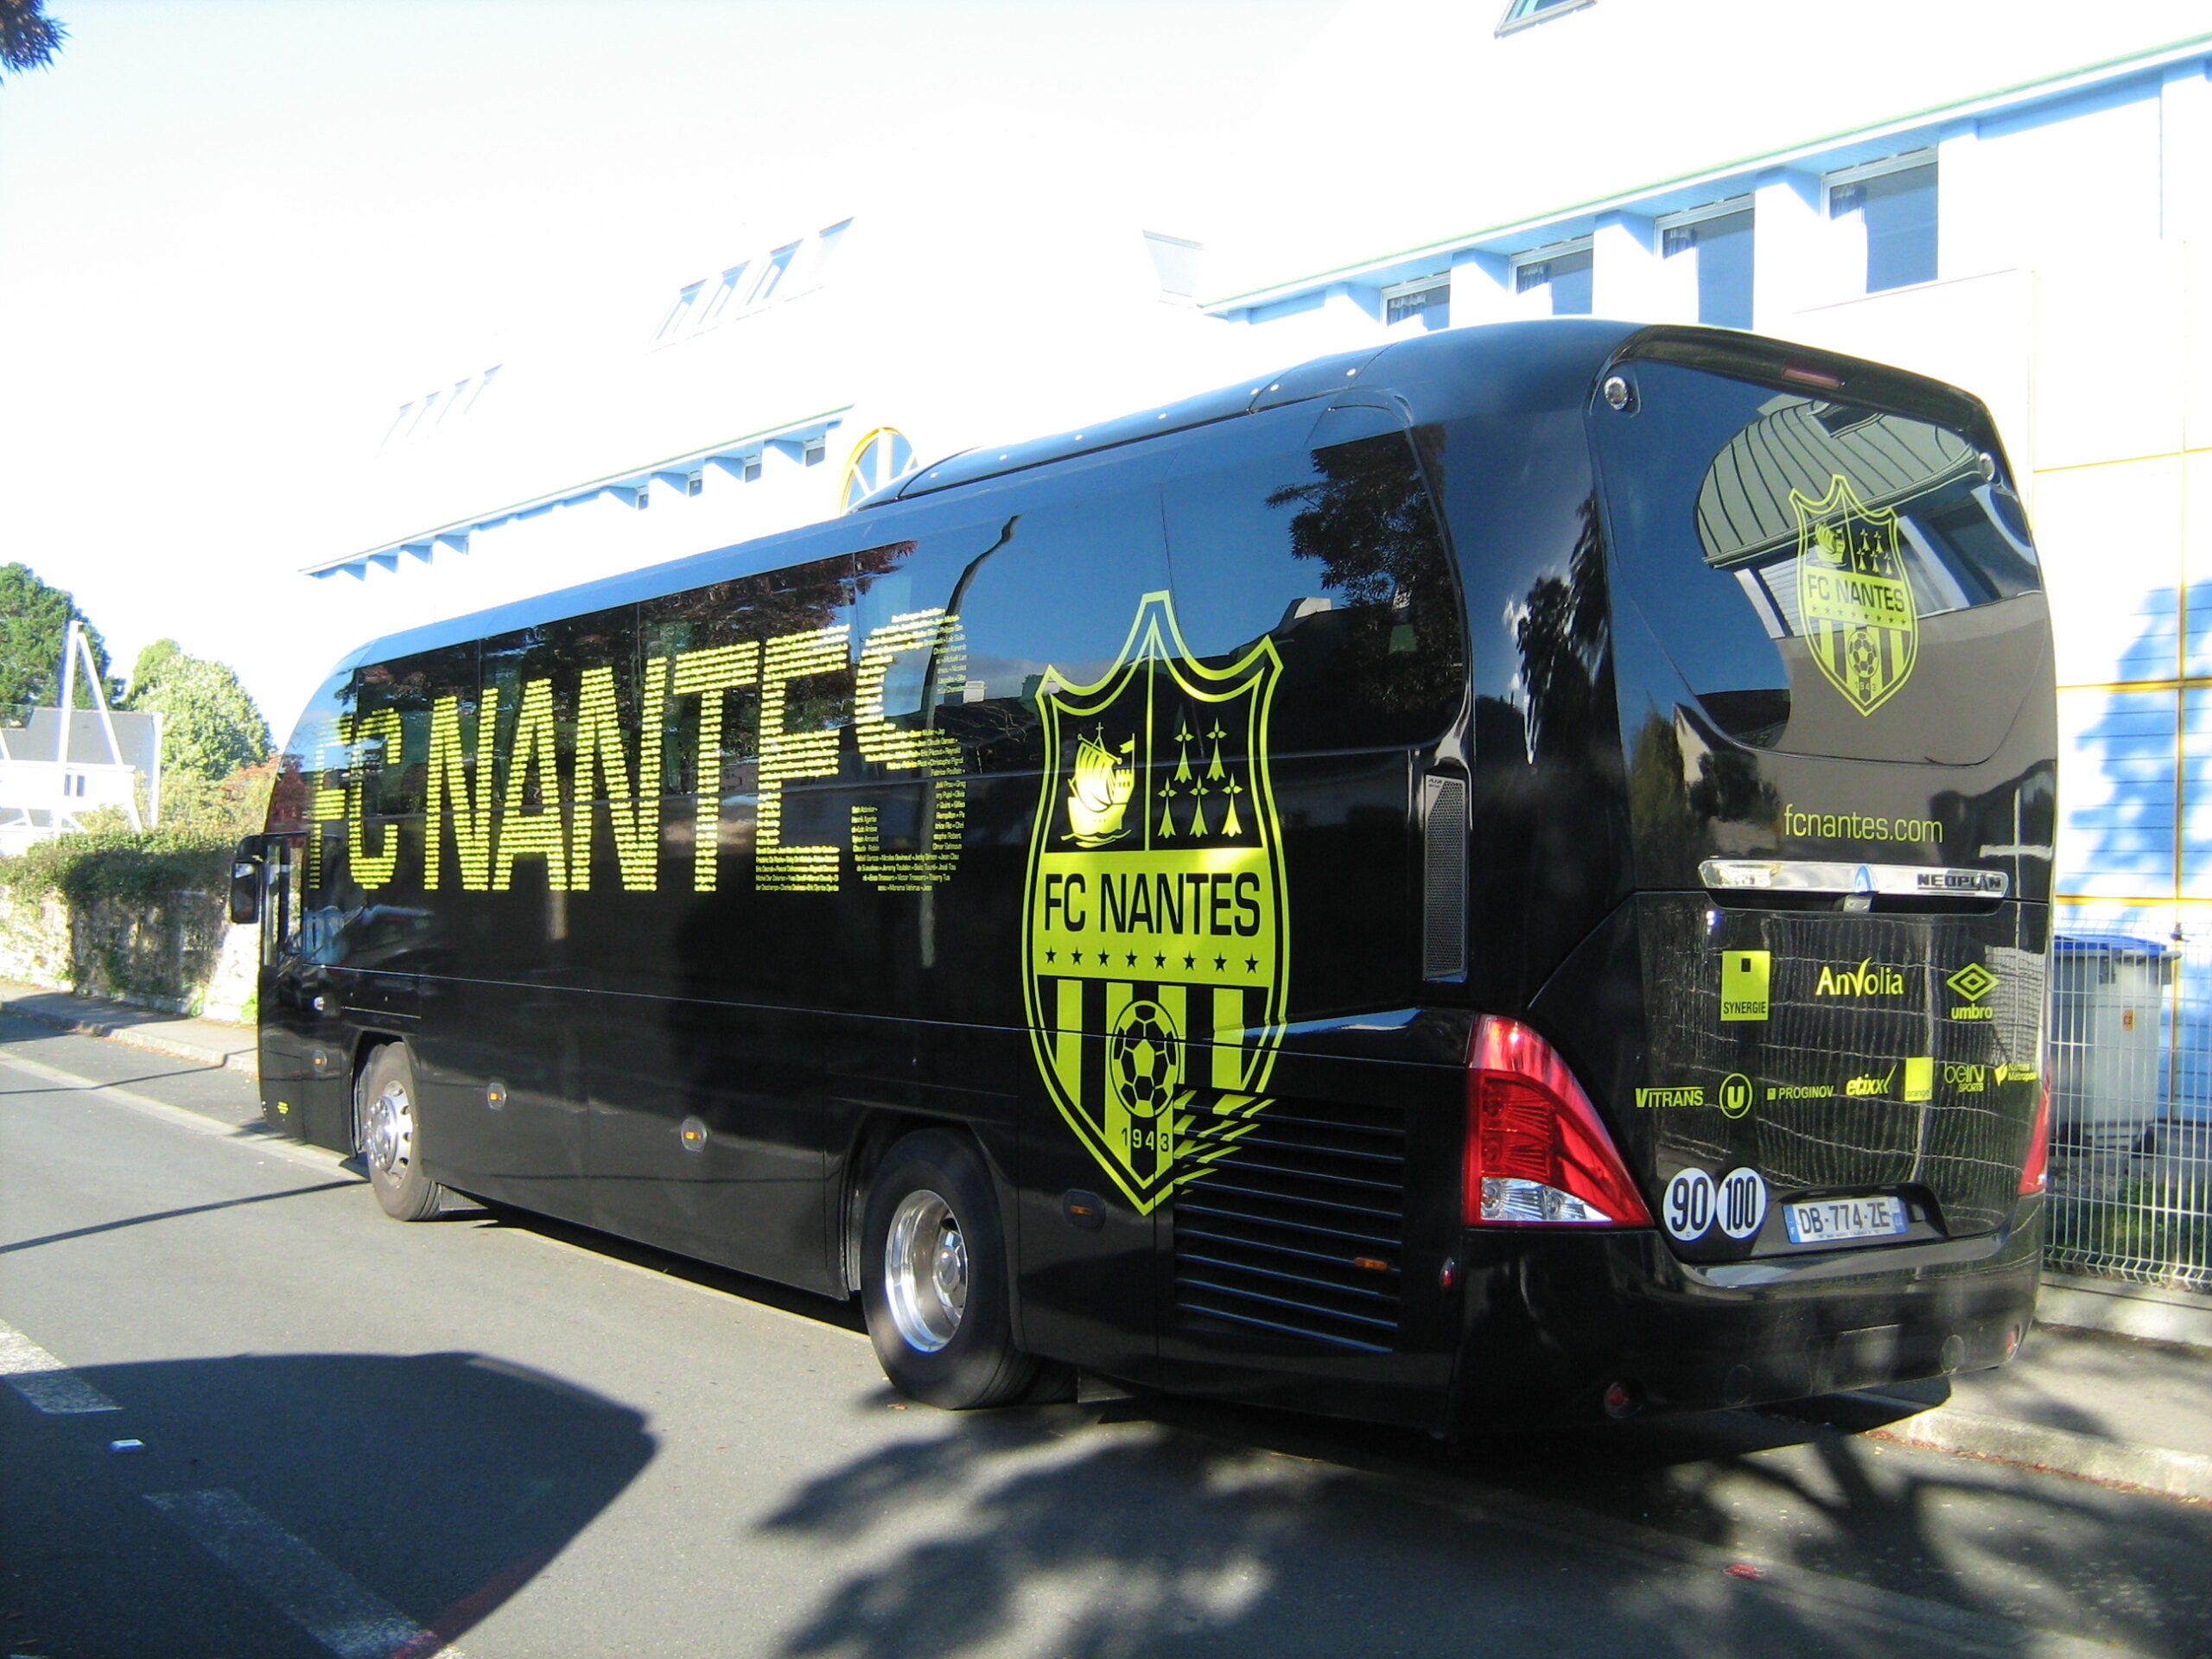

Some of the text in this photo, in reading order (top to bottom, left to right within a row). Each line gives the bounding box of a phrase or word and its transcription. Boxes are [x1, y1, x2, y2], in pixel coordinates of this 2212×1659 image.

[1808, 574, 1904, 612] FC NANTES
[1855, 681, 1877, 692] 1943
[308, 607, 966, 893] FC NANTES
[1783, 804, 1943, 843] fcnantes.com
[1917, 874, 2002, 890] NEOPLAN
[1045, 872, 1260, 937] FC NANTES
[1723, 1001, 1767, 1015] SYNERGIE
[1951, 1003, 1993, 1020] umbro
[1727, 1085, 1745, 1109] U
[1778, 1085, 1834, 1100] PROGINOV
[1906, 1089, 1930, 1098] orange
[1958, 1083, 1984, 1093] SPORTS
[1121, 1127, 1170, 1153] 1943
[1671, 1177, 1709, 1232] 90
[1726, 1176, 1757, 1231] 100
[1797, 1202, 1891, 1234] DB-774-ZE
